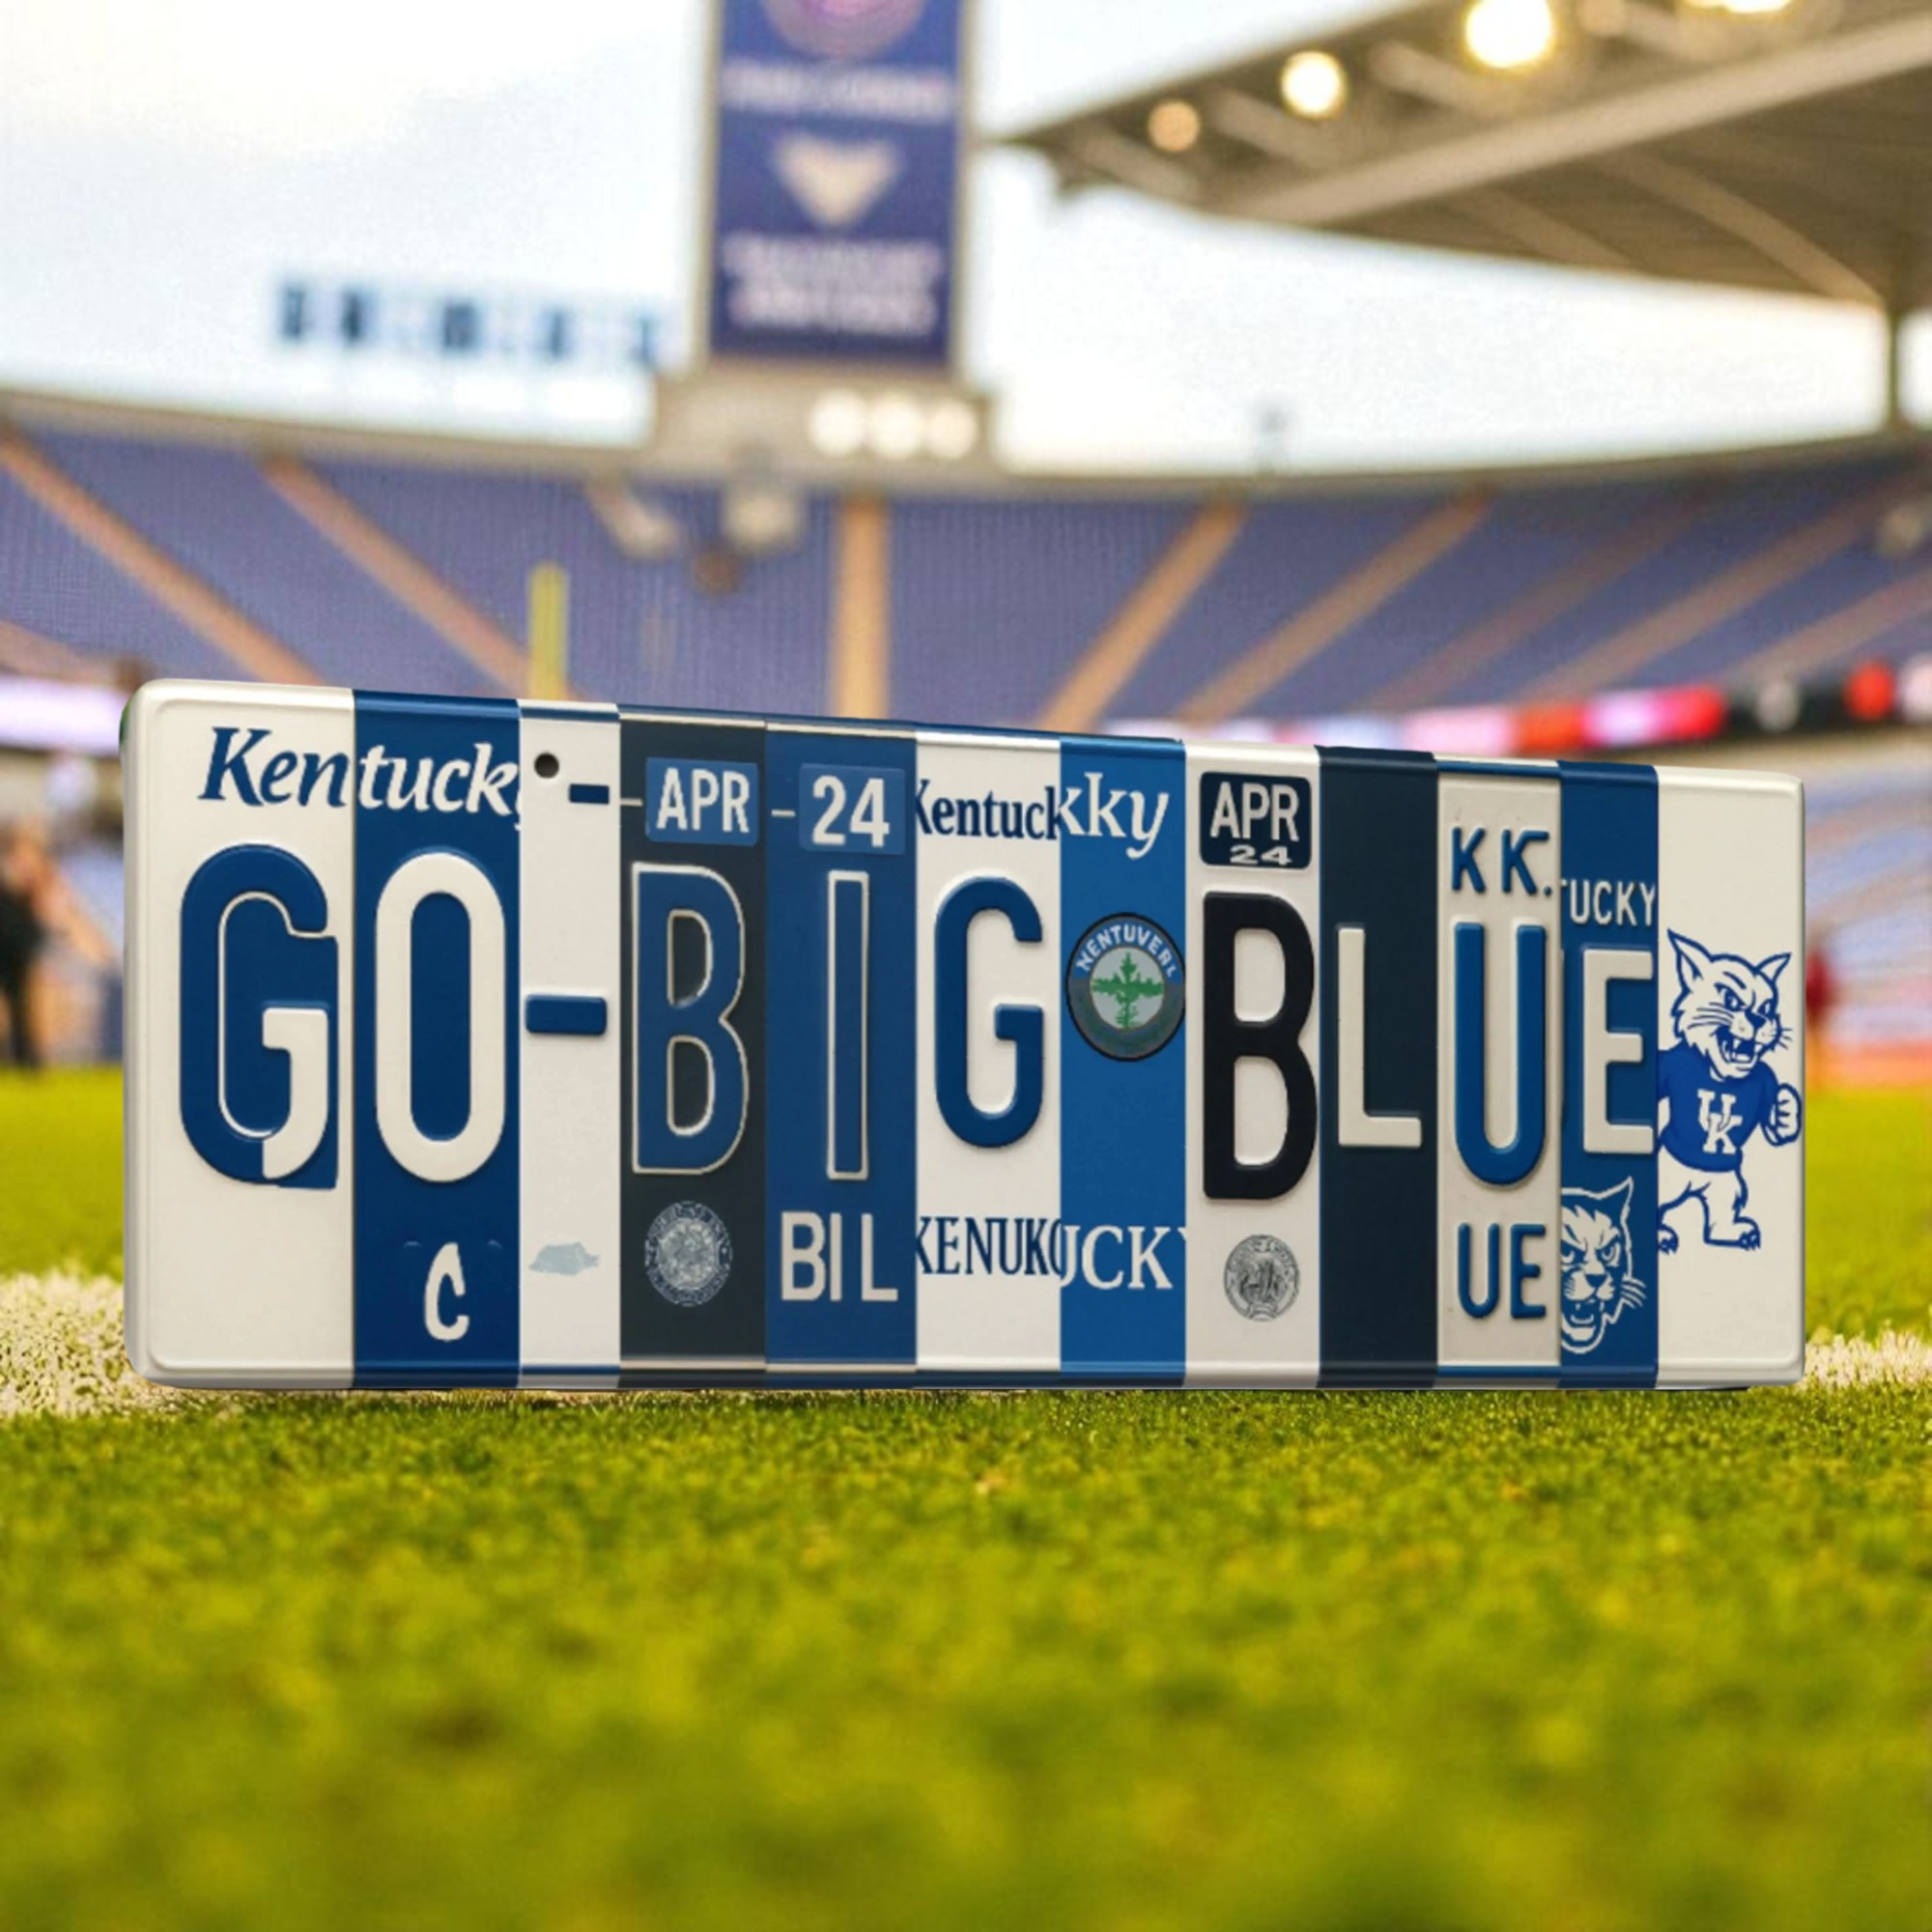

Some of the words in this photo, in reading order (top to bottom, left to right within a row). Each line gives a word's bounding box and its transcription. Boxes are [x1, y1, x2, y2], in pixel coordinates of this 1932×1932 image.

[197, 726, 521, 831] Kentuck
[656, 767, 750, 834] APR
[812, 775, 890, 848] 24
[1209, 781, 1299, 841] APR
[1230, 844, 1293, 866] 24
[1560, 879, 1655, 926] UCKY
[1203, 891, 1654, 1201] BLUE
[1697, 1088, 1743, 1154] UK
[1458, 1223, 1547, 1320] UE
